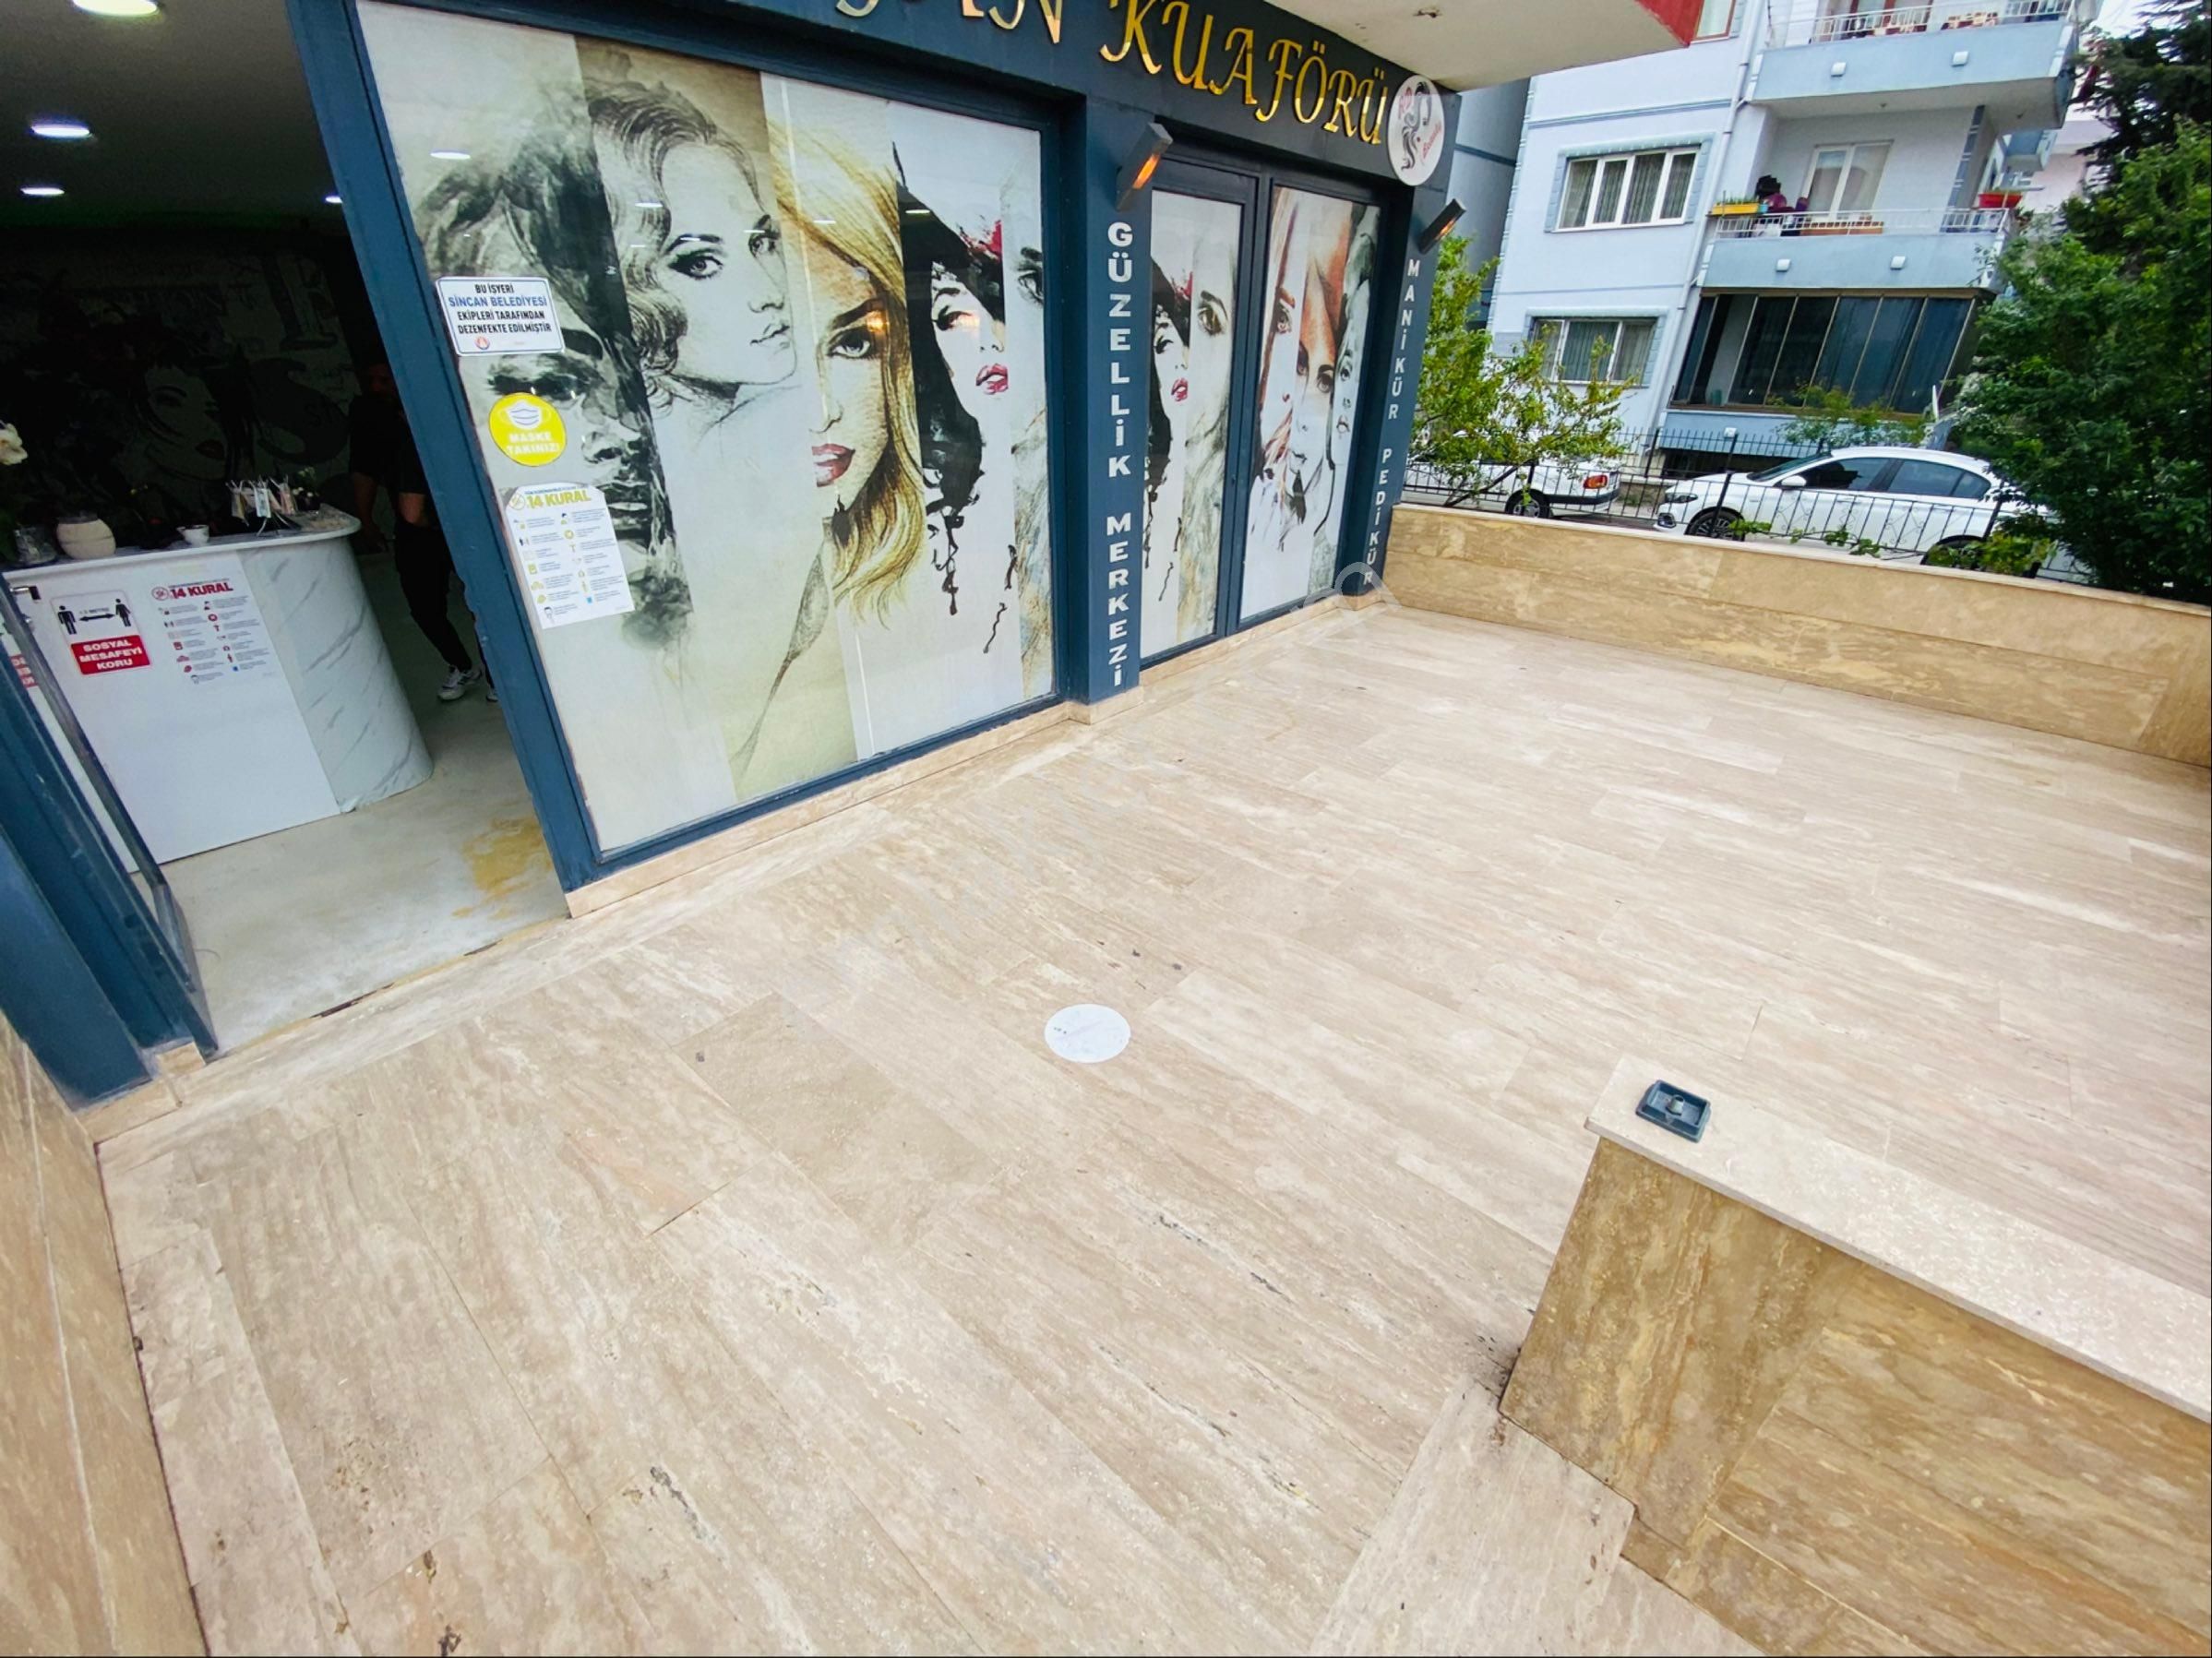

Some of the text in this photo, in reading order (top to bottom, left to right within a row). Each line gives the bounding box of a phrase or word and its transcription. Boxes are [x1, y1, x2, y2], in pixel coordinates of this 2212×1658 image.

[1100, 0, 1388, 145] KUAFÖRÜ
[474, 283, 487, 294] BU
[448, 294, 548, 307] SİNCAN BELEDİYESİ
[458, 310, 545, 321] EKİPLERİ TARAFINDAN
[458, 323, 508, 335] DEZENFEKTE
[1363, 258, 1421, 586] MANİKÜR PEDİKÜR
[1106, 221, 1133, 687] GÜZELLİK MERKEZİ
[544, 489, 592, 507] KURAL
[170, 588, 186, 600] 14
[187, 582, 233, 597] KURAL
[83, 639, 133, 652] SOSYAL
[96, 659, 133, 670] KORU
